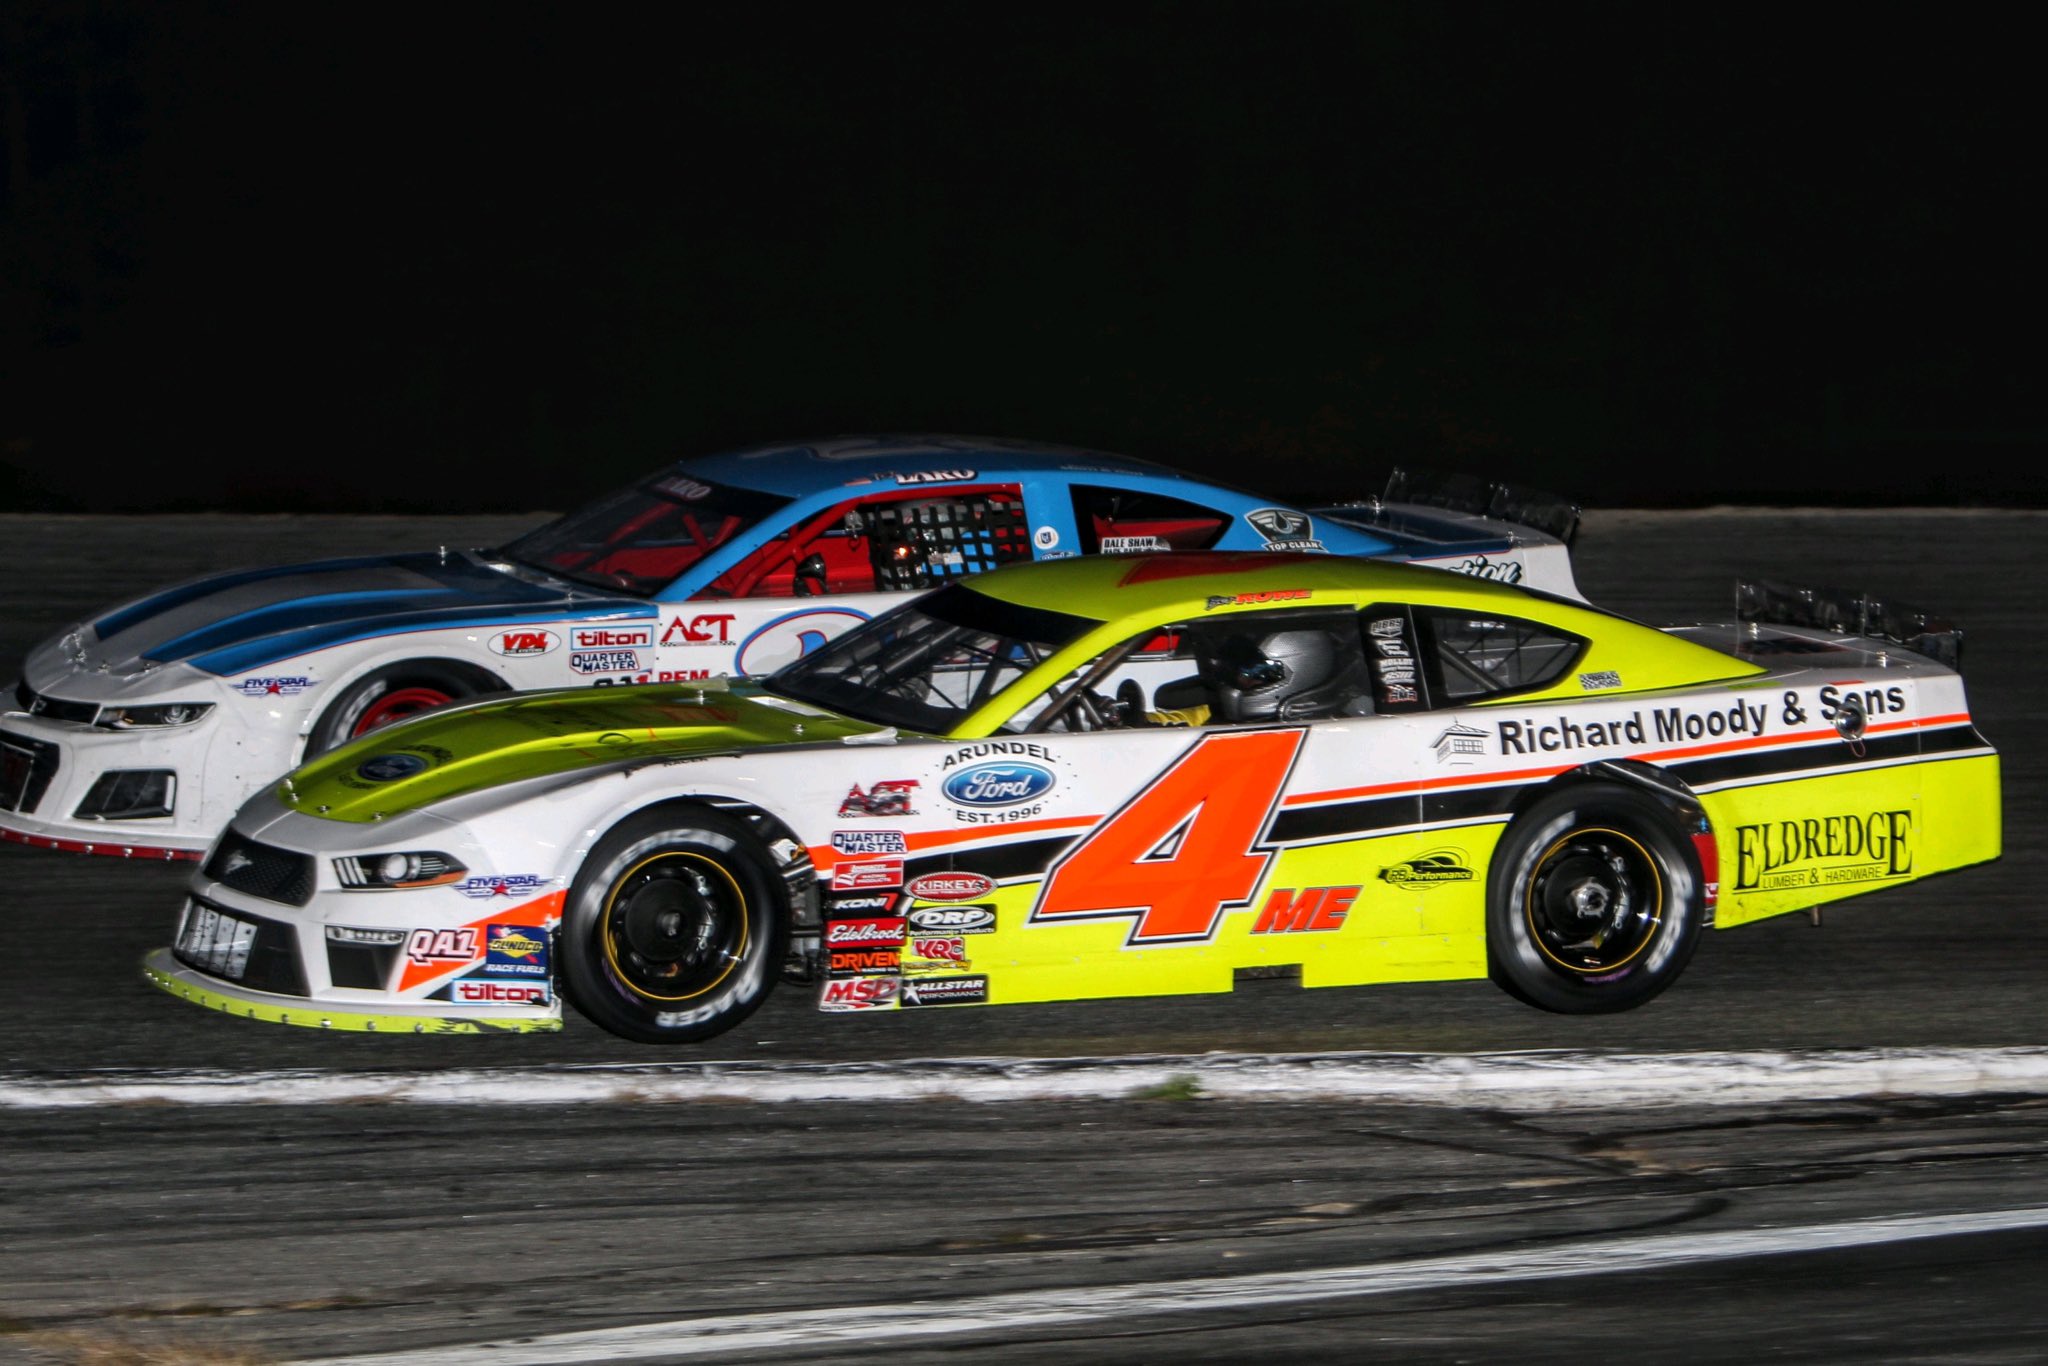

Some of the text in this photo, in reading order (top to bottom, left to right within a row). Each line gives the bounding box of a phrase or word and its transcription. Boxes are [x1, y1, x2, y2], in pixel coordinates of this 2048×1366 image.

[1104, 536, 1154, 549] DALE SHAW
[1269, 541, 1319, 551] TOP CLEAN
[660, 614, 736, 642] ACT
[577, 631, 647, 647] tilton
[572, 652, 632, 667] QUARTER
[582, 660, 636, 672] MASTER
[244, 677, 308, 688] FIVE STAR
[1499, 711, 1647, 756] Richard
[1653, 698, 1767, 745] Moody
[1782, 690, 1807, 726] &
[942, 742, 1057, 771] ARUNDEL
[964, 769, 1032, 800] Ford
[833, 832, 901, 847] QUARTER
[1028, 725, 1310, 949] 4
[845, 842, 904, 853] MASTER
[1734, 810, 1912, 890] ELDREDGE
[467, 875, 538, 889] FIVE STAR
[1408, 871, 1472, 881] Performance
[1763, 865, 1882, 889] LUMBER & HARDWARE
[916, 879, 978, 890] KIRKEY
[834, 897, 888, 910] KONI
[1249, 884, 1364, 935] ME
[921, 910, 985, 925] DRP
[829, 923, 905, 942] Edelbrock
[909, 927, 995, 937] Performance Products
[408, 928, 476, 963] QA1
[490, 939, 544, 952] SUNOCO
[913, 937, 965, 960] KRC
[487, 964, 546, 973] RACE FUELS
[831, 951, 901, 972] DRIVEN
[459, 983, 544, 1001] tilton
[918, 980, 985, 991] ALLSTAR
[918, 989, 985, 999] PERFORMANCE
